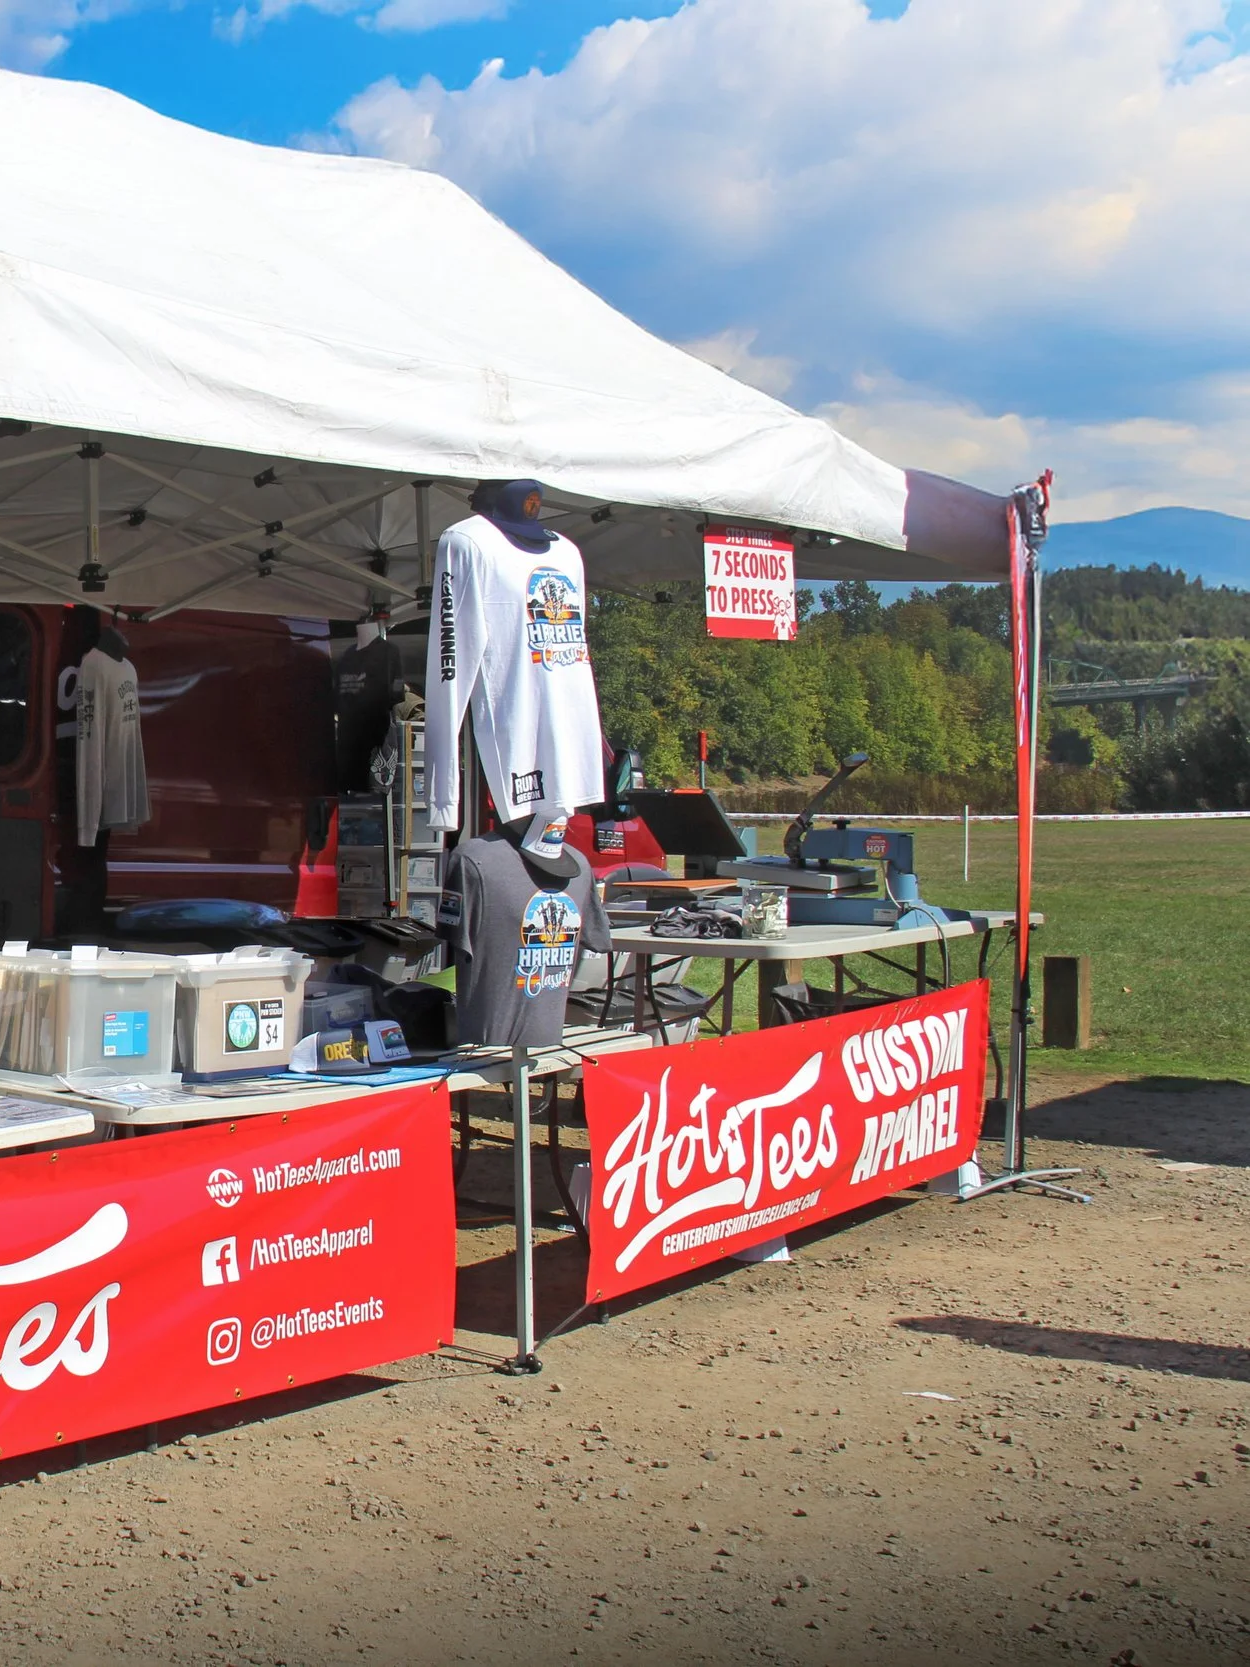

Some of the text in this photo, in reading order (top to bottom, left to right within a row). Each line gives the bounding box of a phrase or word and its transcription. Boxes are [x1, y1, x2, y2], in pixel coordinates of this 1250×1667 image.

[726, 528, 773, 548] STEP THREE
[712, 550, 787, 581] 7 SECONDS
[709, 586, 777, 616] TO PRESS
[514, 774, 539, 794] RUN
[266, 1023, 278, 1046] $4
[841, 1008, 968, 1103] CUSTOM
[602, 1051, 839, 1228] Hot Tees
[849, 1085, 959, 1185] APPAREL
[252, 1147, 401, 1194] HotTeesApparel.com
[250, 1219, 373, 1271] /HotTeesApparel
[251, 1296, 384, 1349] @HotTeesEvents
